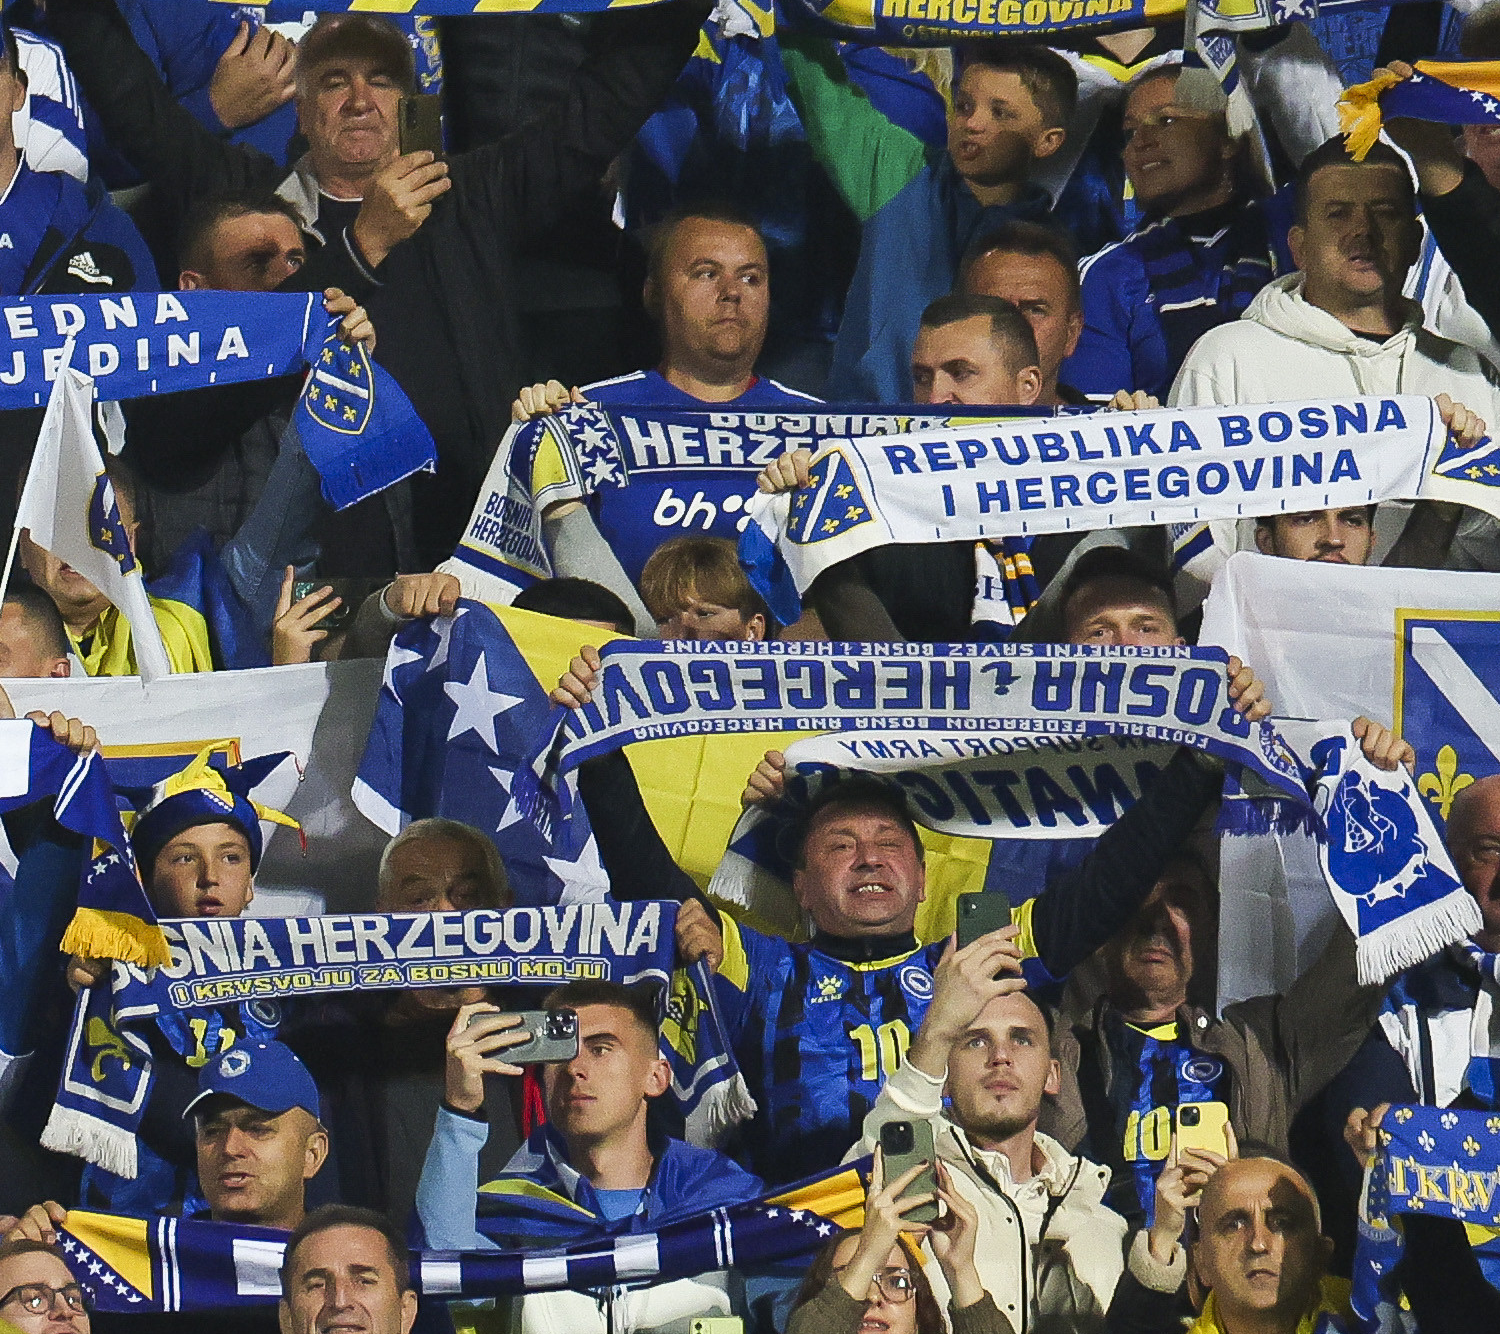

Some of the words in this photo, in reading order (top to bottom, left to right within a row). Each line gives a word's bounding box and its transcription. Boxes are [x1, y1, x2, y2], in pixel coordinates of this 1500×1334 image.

[890, 418, 1201, 474] REPUBLIKA
[1218, 400, 1407, 447] BOSNA
[942, 485, 955, 516] I
[976, 449, 1361, 513] HERCEGOVINA
[286, 902, 660, 968] HERZEGOVINA
[409, 962, 510, 981] BOSNU
[518, 959, 610, 980] MOJU
[850, 1021, 912, 1080] 10
